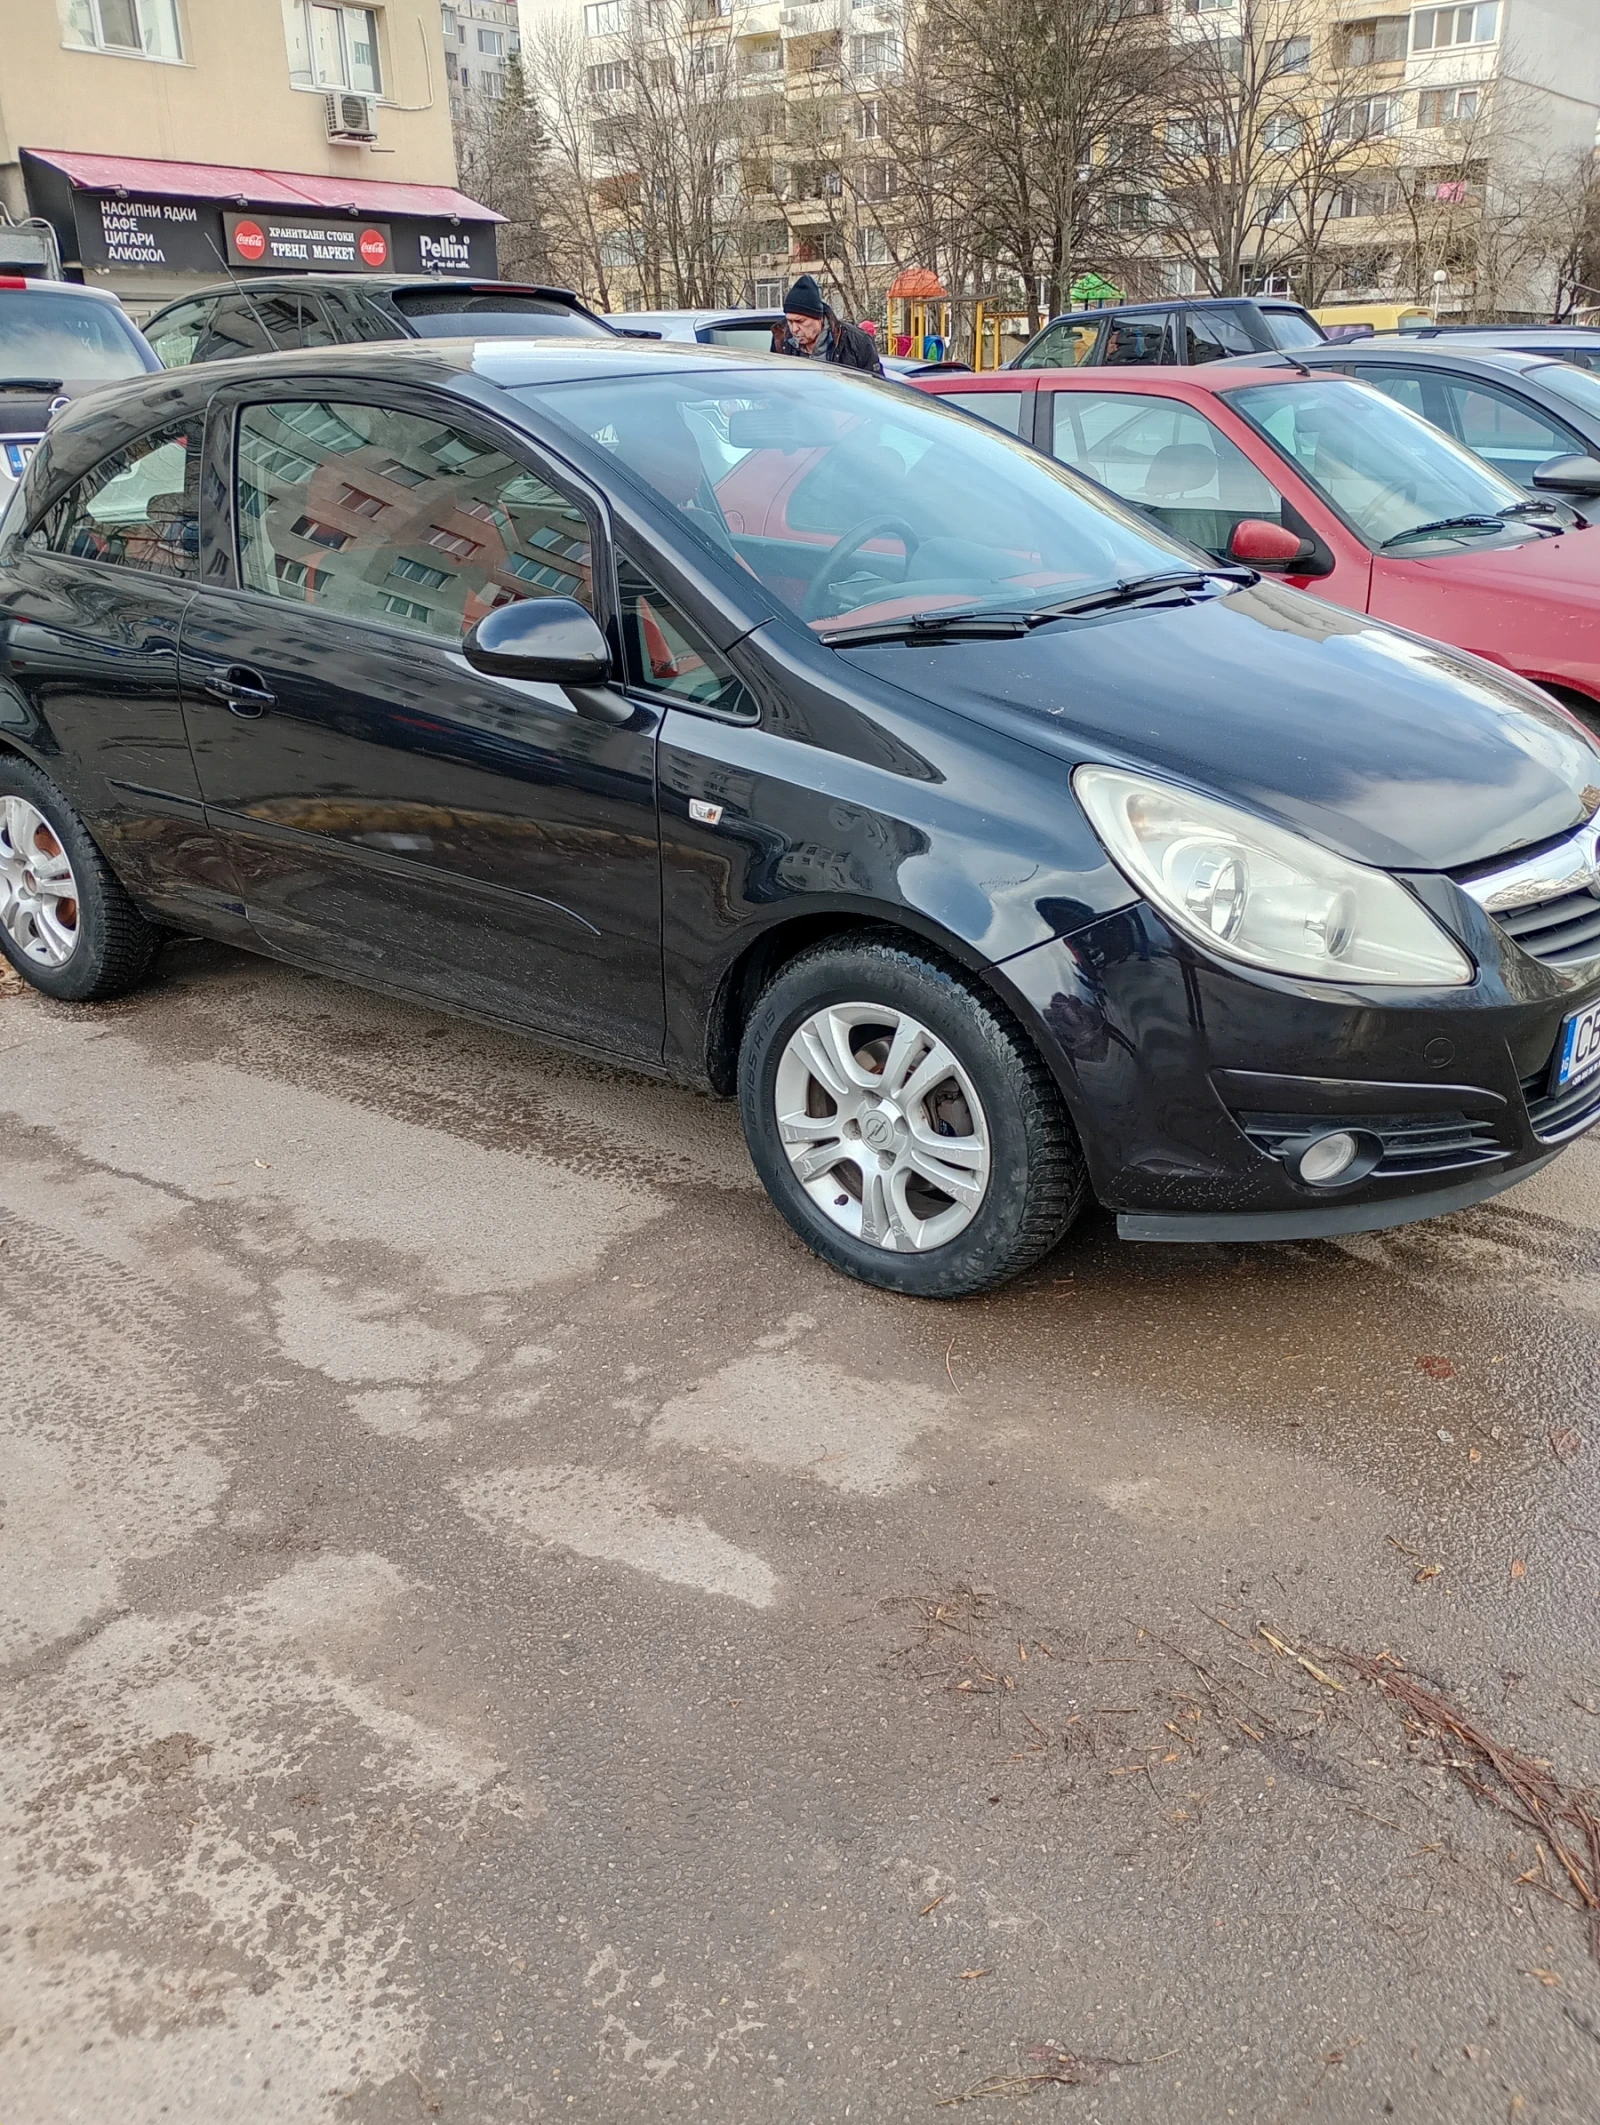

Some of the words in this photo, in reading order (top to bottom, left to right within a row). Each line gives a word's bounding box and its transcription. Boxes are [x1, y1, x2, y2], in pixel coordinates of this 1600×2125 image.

[100, 200, 161, 219] НАСИПНИ
[163, 206, 197, 222] ЯДКИ
[102, 215, 139, 231] КАФЕ
[104, 230, 155, 247] ЦИГАРИ
[268, 226, 326, 241] ХРАНИТЕЛНИ
[326, 231, 355, 243] СТОКИ
[108, 246, 166, 263] АЛКОХОЛ
[270, 242, 309, 260] ТРЕНД
[312, 244, 355, 261] МАРКЕТ
[419, 234, 470, 260] Pellini
